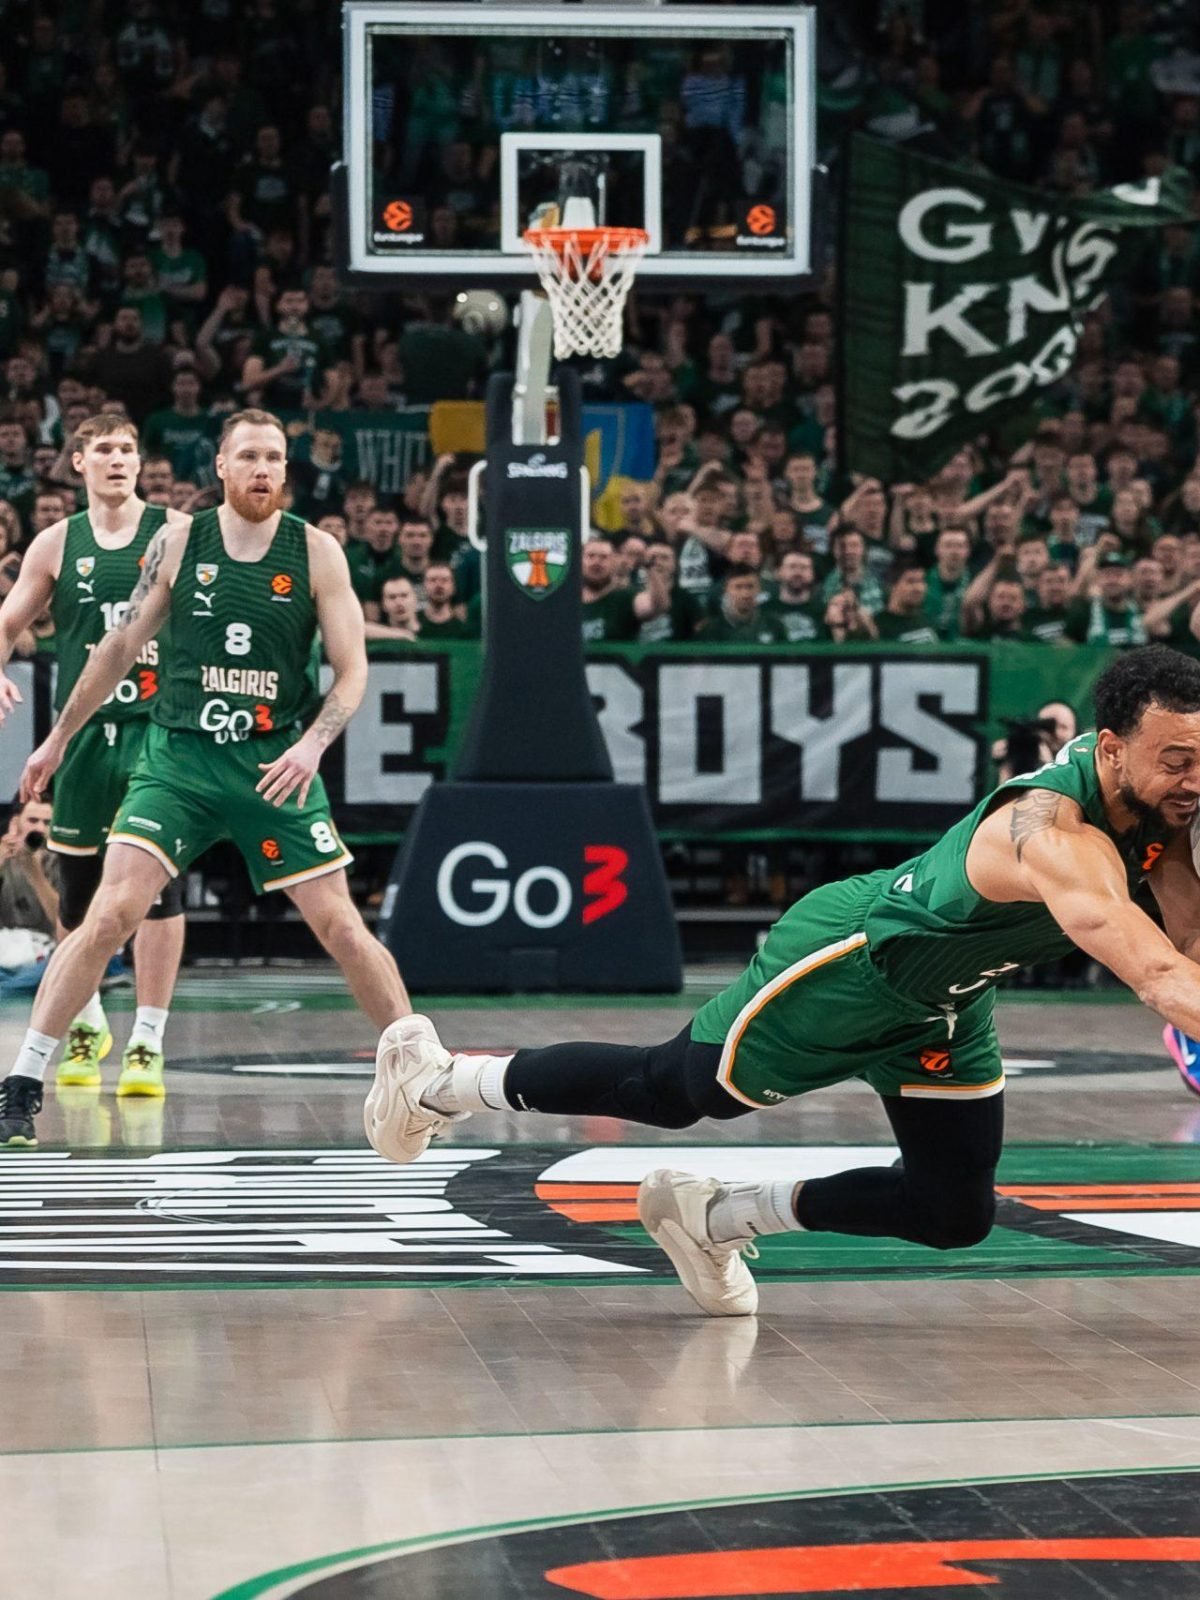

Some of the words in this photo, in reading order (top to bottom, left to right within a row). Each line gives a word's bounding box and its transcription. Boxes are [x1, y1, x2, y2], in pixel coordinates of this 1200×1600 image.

[224, 622, 253, 656] 8
[103, 670, 158, 705] o3
[199, 698, 274, 732] Go3
[310, 821, 337, 854] 8
[437, 840, 629, 930] Go3
